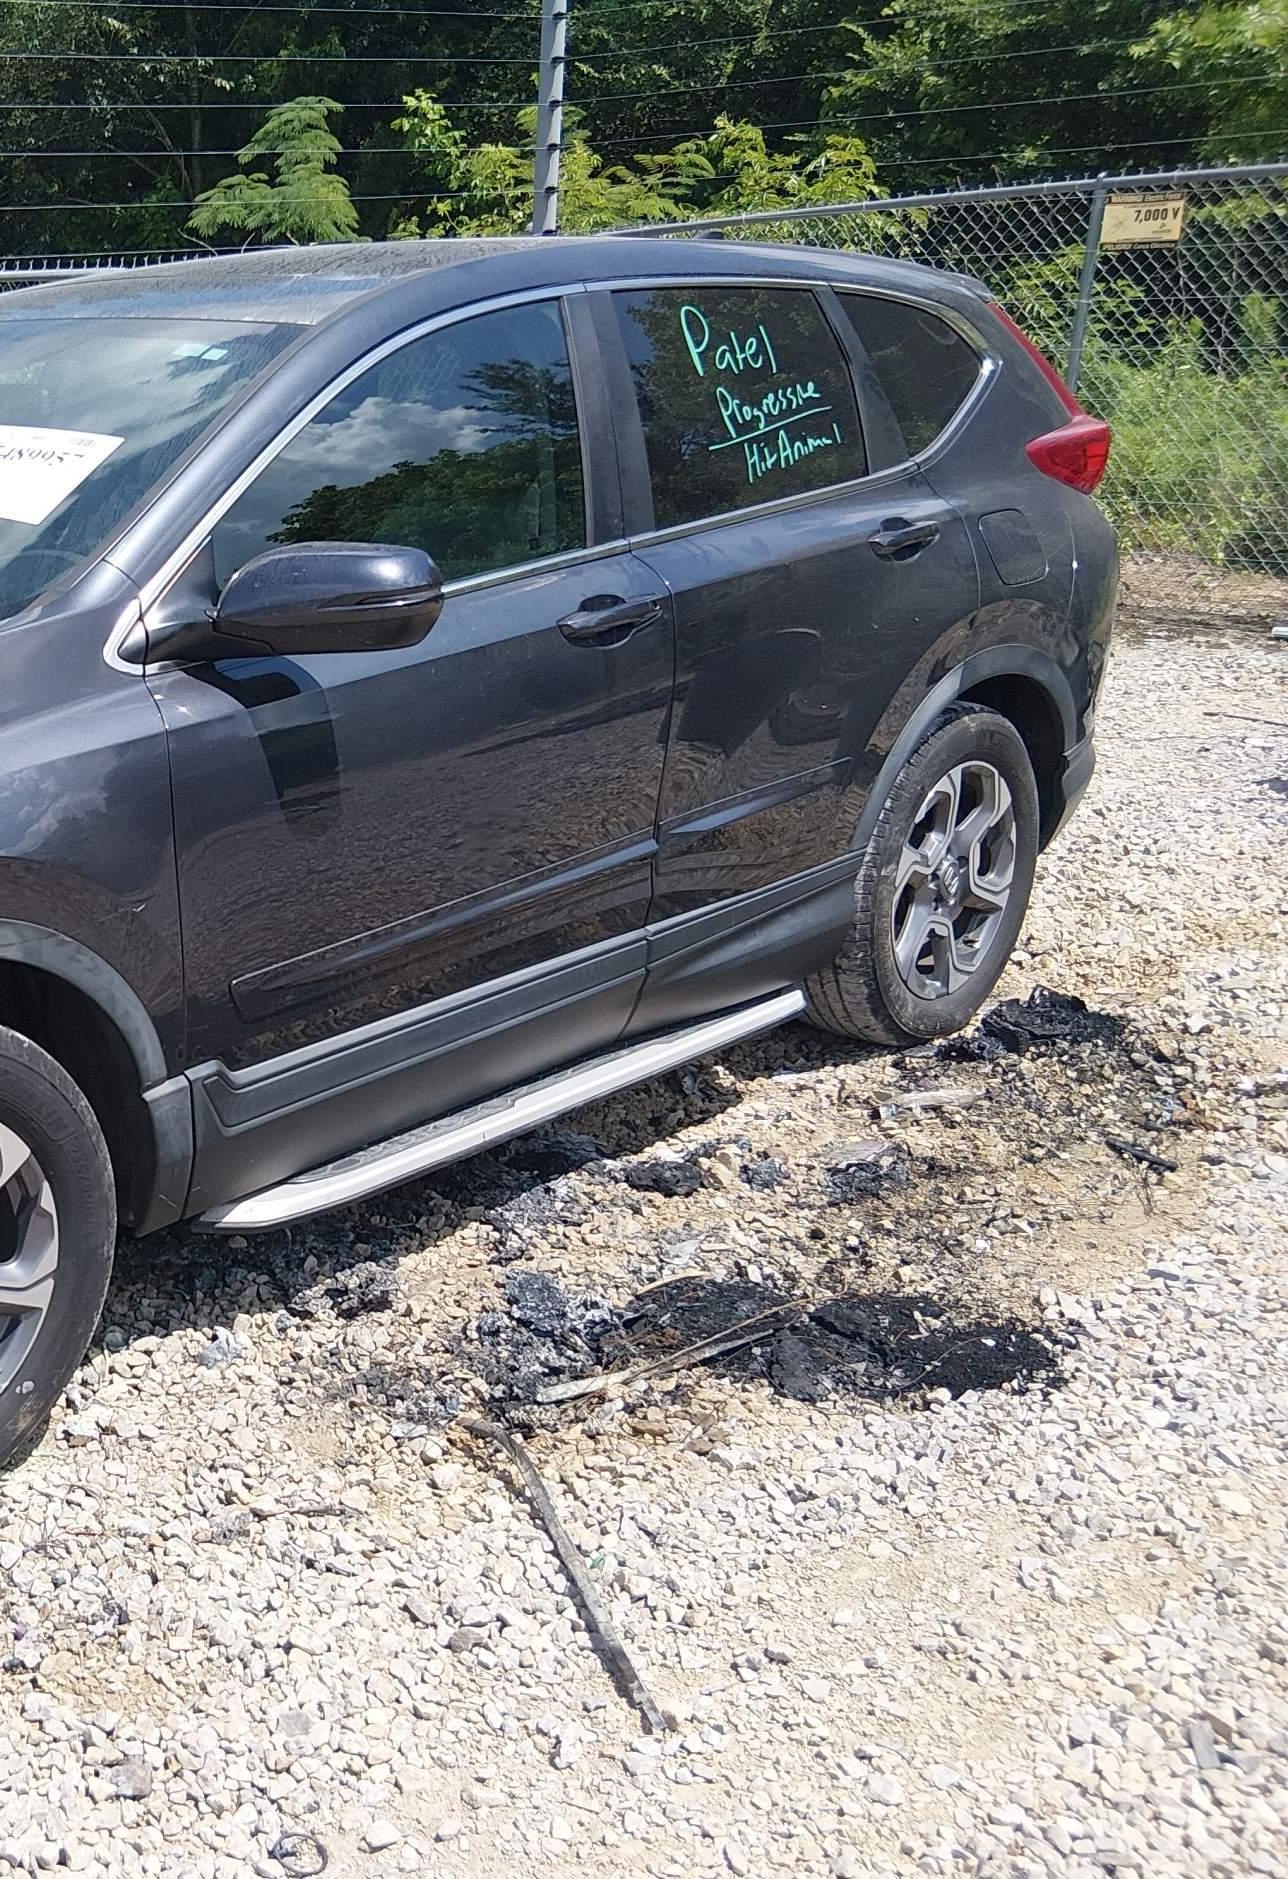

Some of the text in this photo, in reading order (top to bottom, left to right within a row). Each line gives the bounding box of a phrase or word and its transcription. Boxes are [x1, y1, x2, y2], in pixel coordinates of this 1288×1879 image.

[1134, 207, 1182, 225] 7,000 V
[680, 305, 776, 376] Patel
